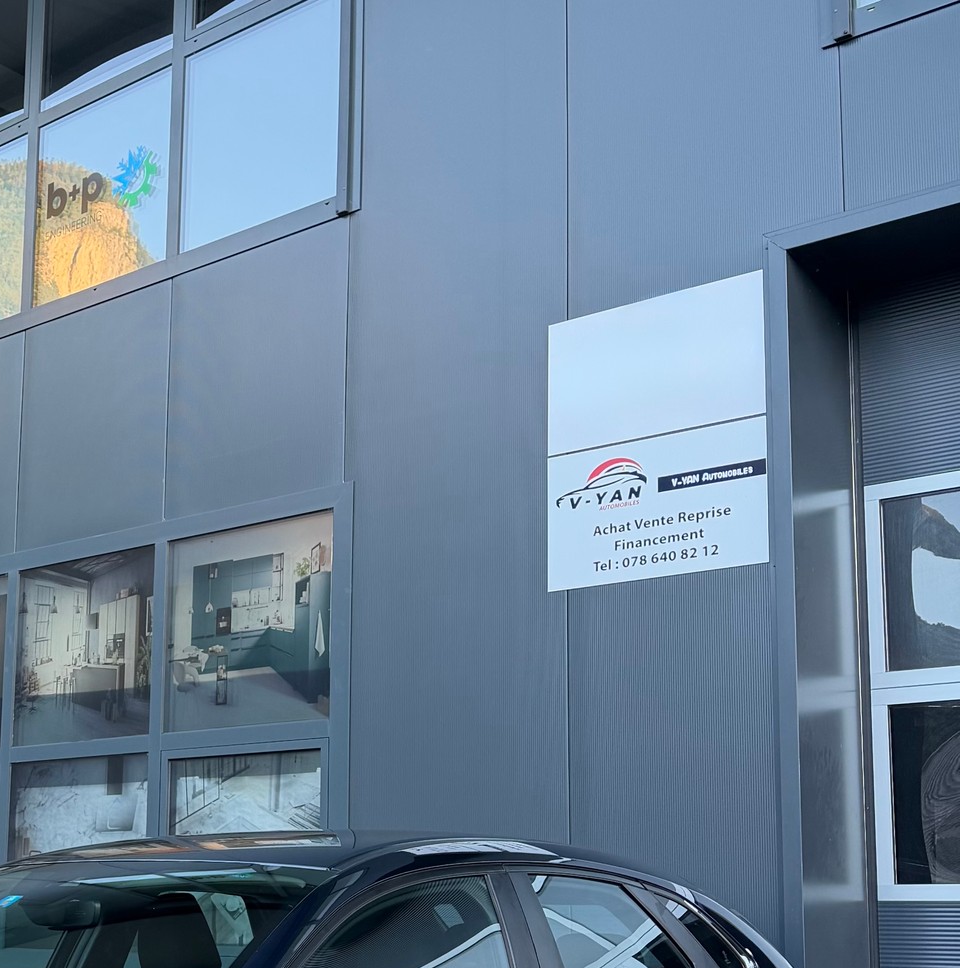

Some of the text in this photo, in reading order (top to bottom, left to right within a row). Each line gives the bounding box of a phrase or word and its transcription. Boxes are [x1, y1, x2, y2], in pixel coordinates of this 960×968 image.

[46, 172, 104, 219] b+p
[45, 210, 103, 241] ENGINEERING
[671, 474, 700, 487] V-YAN
[569, 485, 642, 510] V-YAN
[599, 499, 641, 512] AUTOMOBILES
[593, 505, 732, 537] Achat Vente Reprise
[614, 528, 705, 551] Financement
[622, 554, 648, 569] 078
[651, 550, 677, 565] 640
[680, 547, 698, 560] 82
[702, 544, 720, 557] 12
